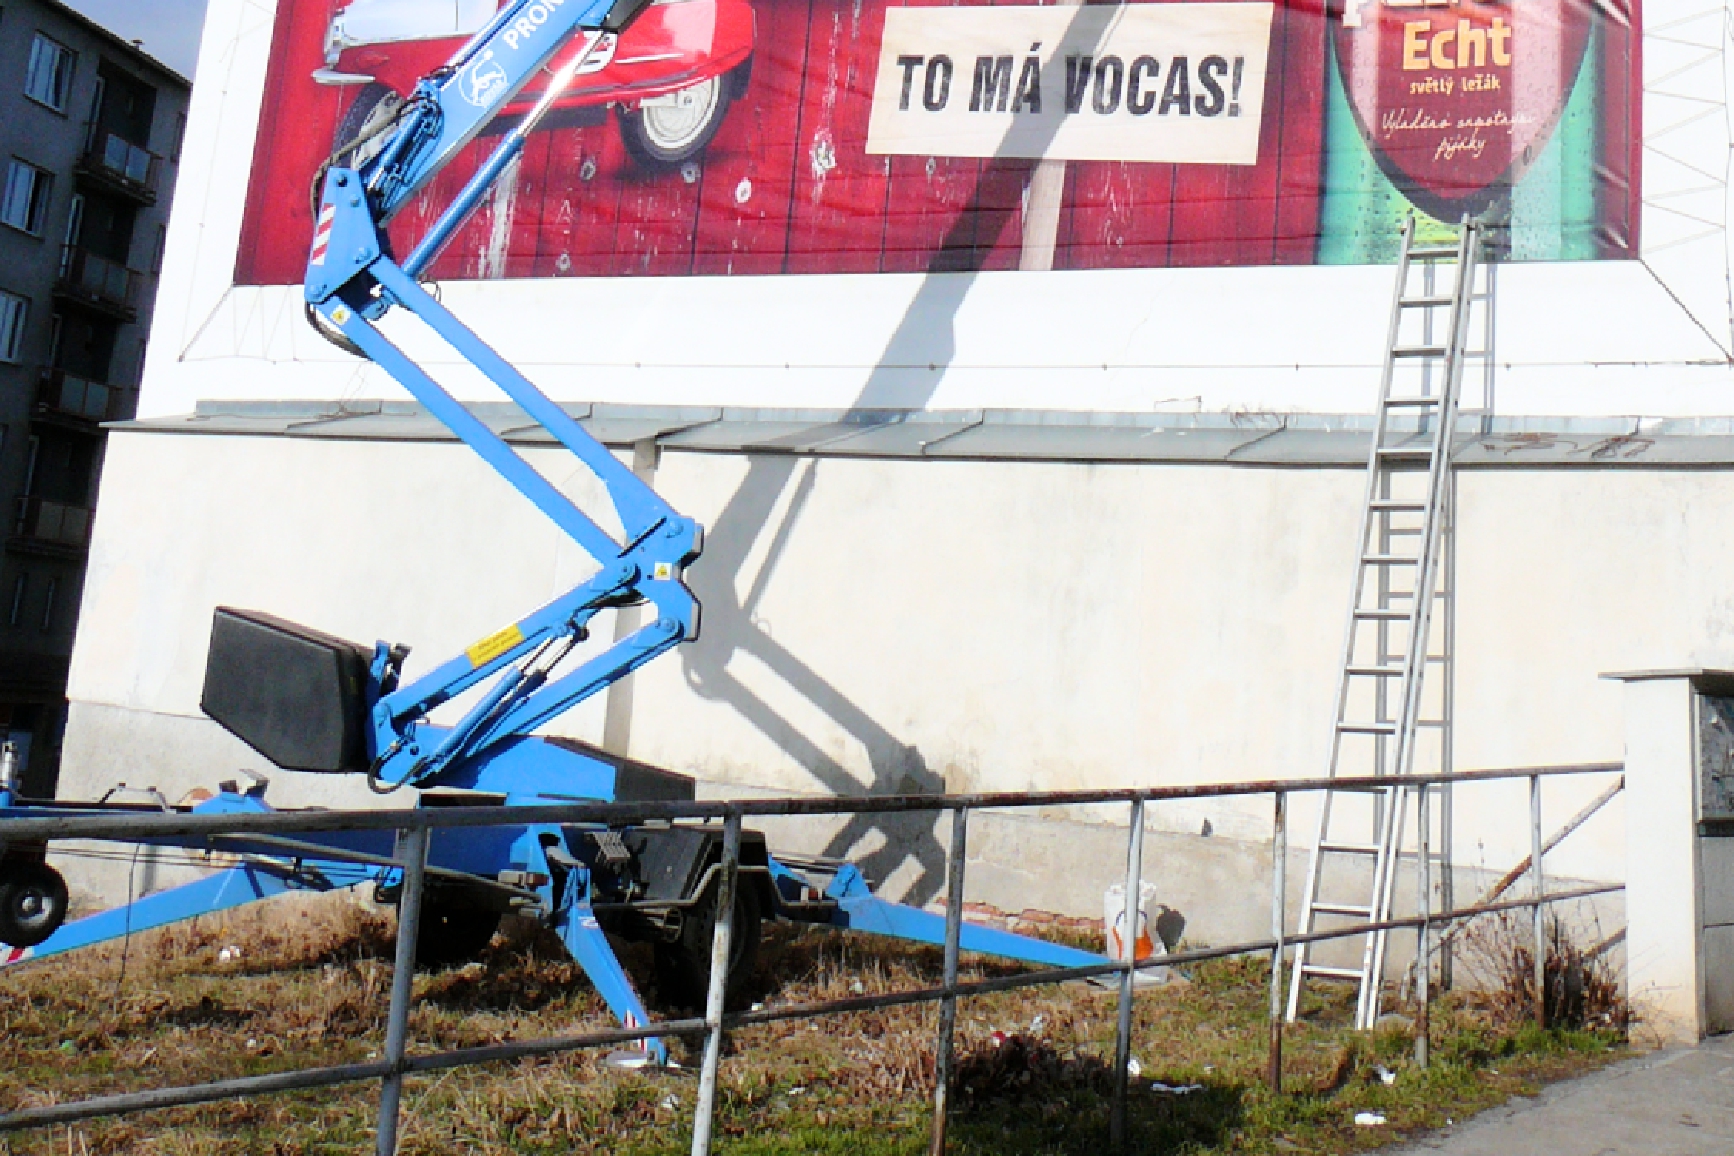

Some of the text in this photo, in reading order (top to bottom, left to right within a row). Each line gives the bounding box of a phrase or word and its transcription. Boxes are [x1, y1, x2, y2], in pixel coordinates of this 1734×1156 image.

[1403, 17, 1511, 70] Echt
[896, 41, 1245, 117] TO MÁ VOCAS!
[1409, 73, 1501, 96] světlý ležák
